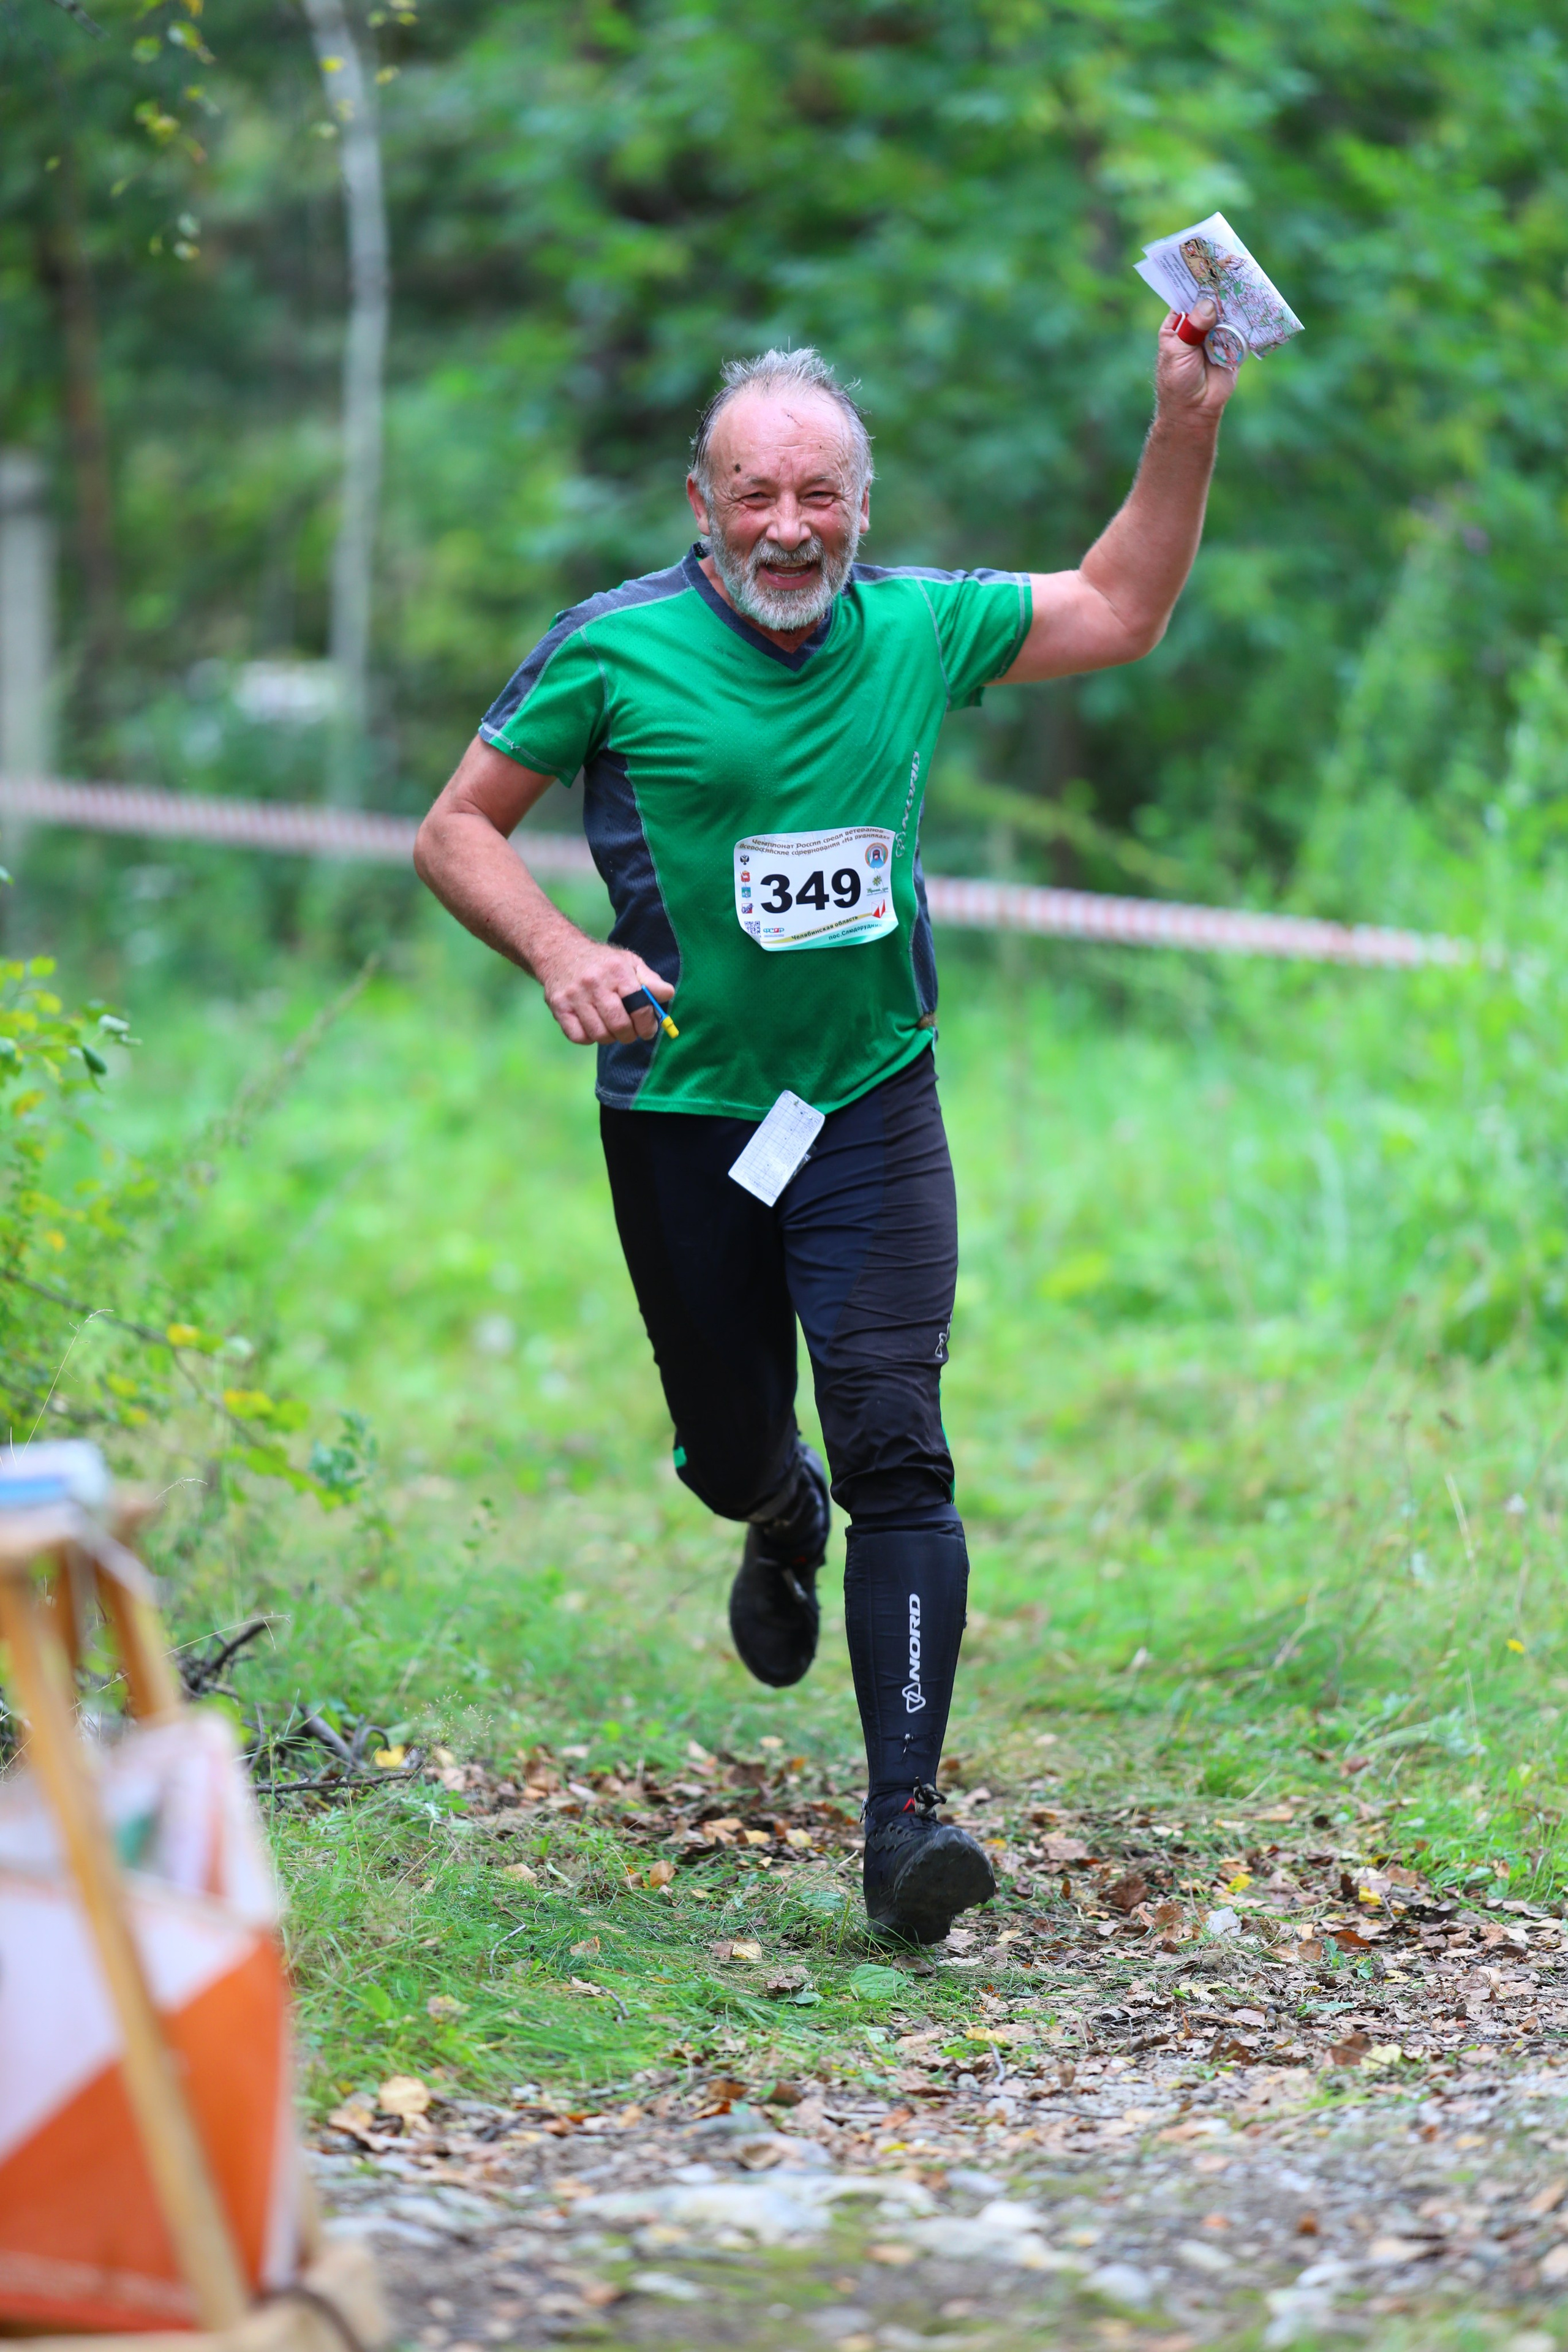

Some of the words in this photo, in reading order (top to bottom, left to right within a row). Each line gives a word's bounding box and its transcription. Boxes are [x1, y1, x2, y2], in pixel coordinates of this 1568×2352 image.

[902, 751, 920, 831] NORD
[739, 843, 790, 856] Всероссийские
[792, 841, 840, 856] соревнования
[842, 836, 853, 845] «На
[752, 839, 794, 850] Чемпионат
[796, 840, 821, 848] России
[823, 833, 843, 843] среди
[845, 827, 884, 836] ветеранов
[760, 868, 861, 913] 349
[791, 924, 834, 940] Челябинская
[835, 915, 858, 927] область
[909, 1593, 921, 1682] NORD
